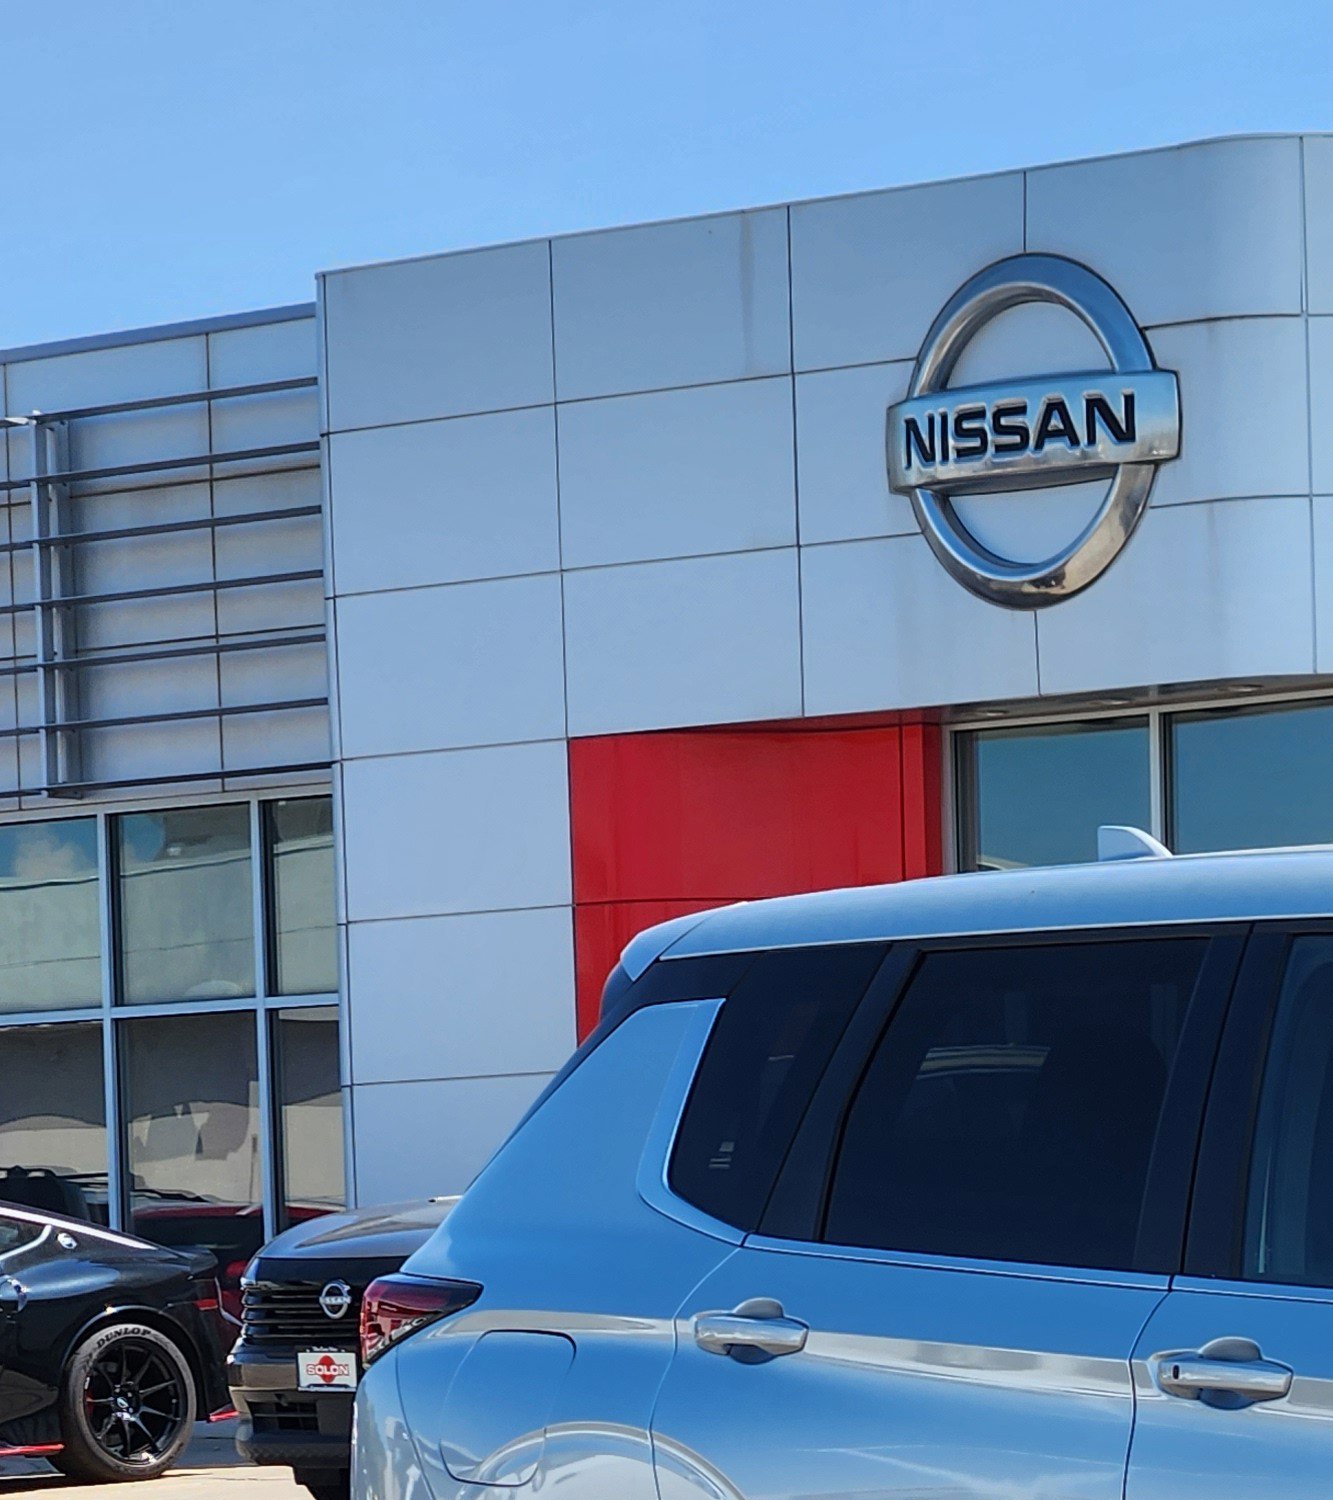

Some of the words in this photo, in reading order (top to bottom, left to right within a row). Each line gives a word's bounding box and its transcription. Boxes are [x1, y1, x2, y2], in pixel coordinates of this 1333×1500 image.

[904, 390, 1137, 470] NISSAN
[96, 1327, 152, 1349] DUNLOP
[306, 1364, 349, 1376] SOLON
